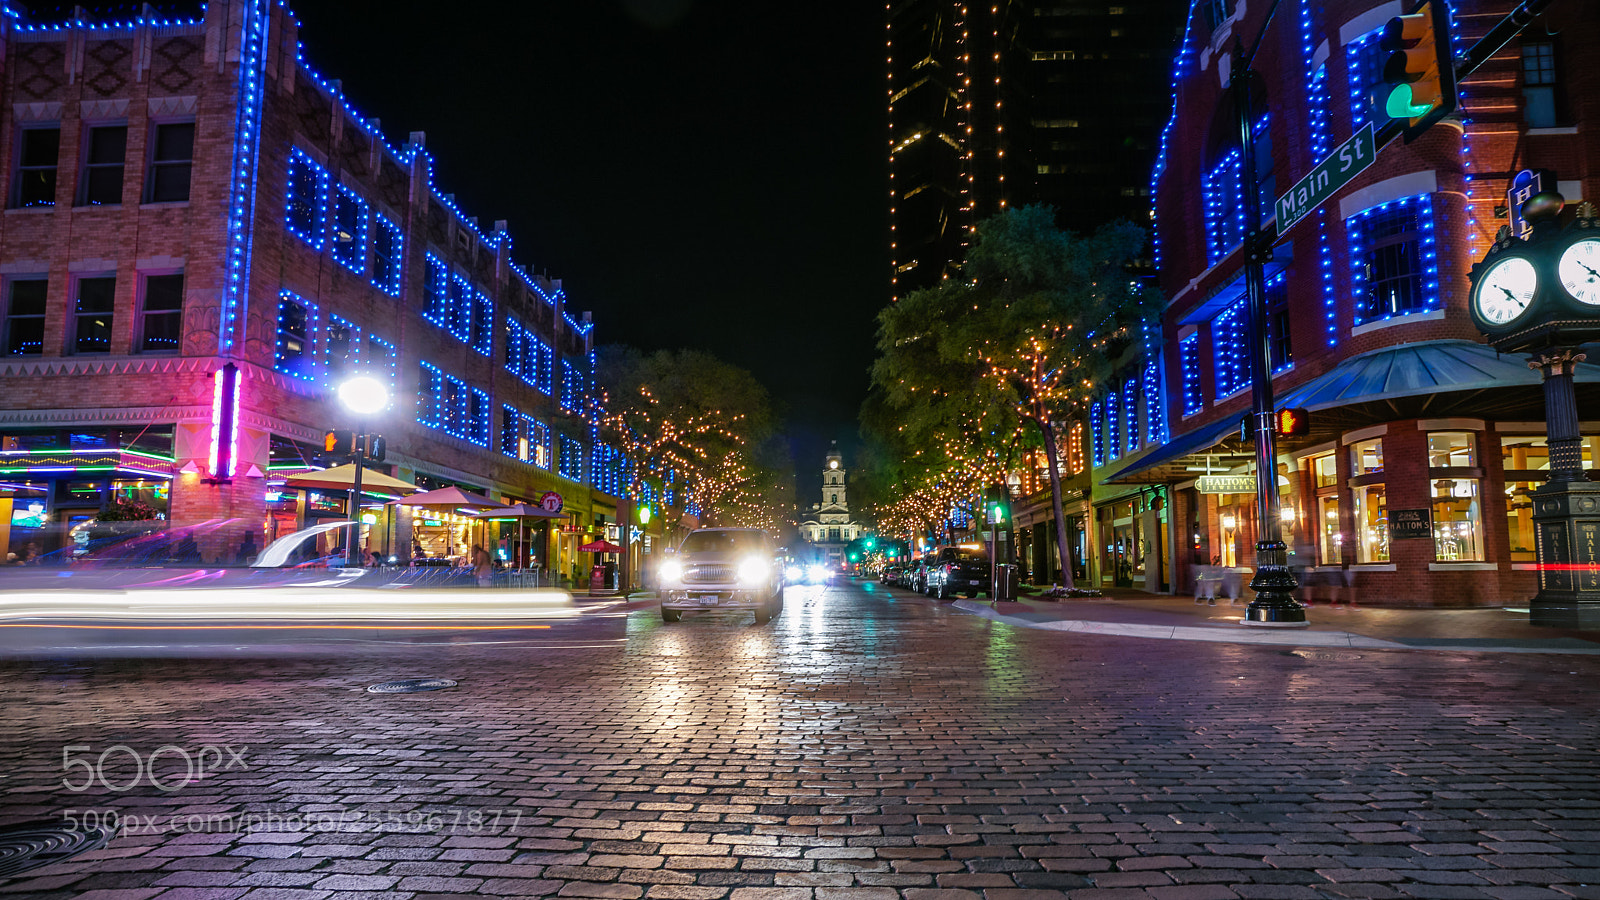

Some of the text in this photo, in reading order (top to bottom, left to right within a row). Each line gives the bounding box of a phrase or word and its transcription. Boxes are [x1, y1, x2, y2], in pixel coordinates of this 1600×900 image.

[1282, 137, 1364, 219] Main St
[1292, 205, 1307, 221] 300
[1206, 477, 1255, 486] HALTOM'S
[1390, 521, 1430, 530] HALTOM'S
